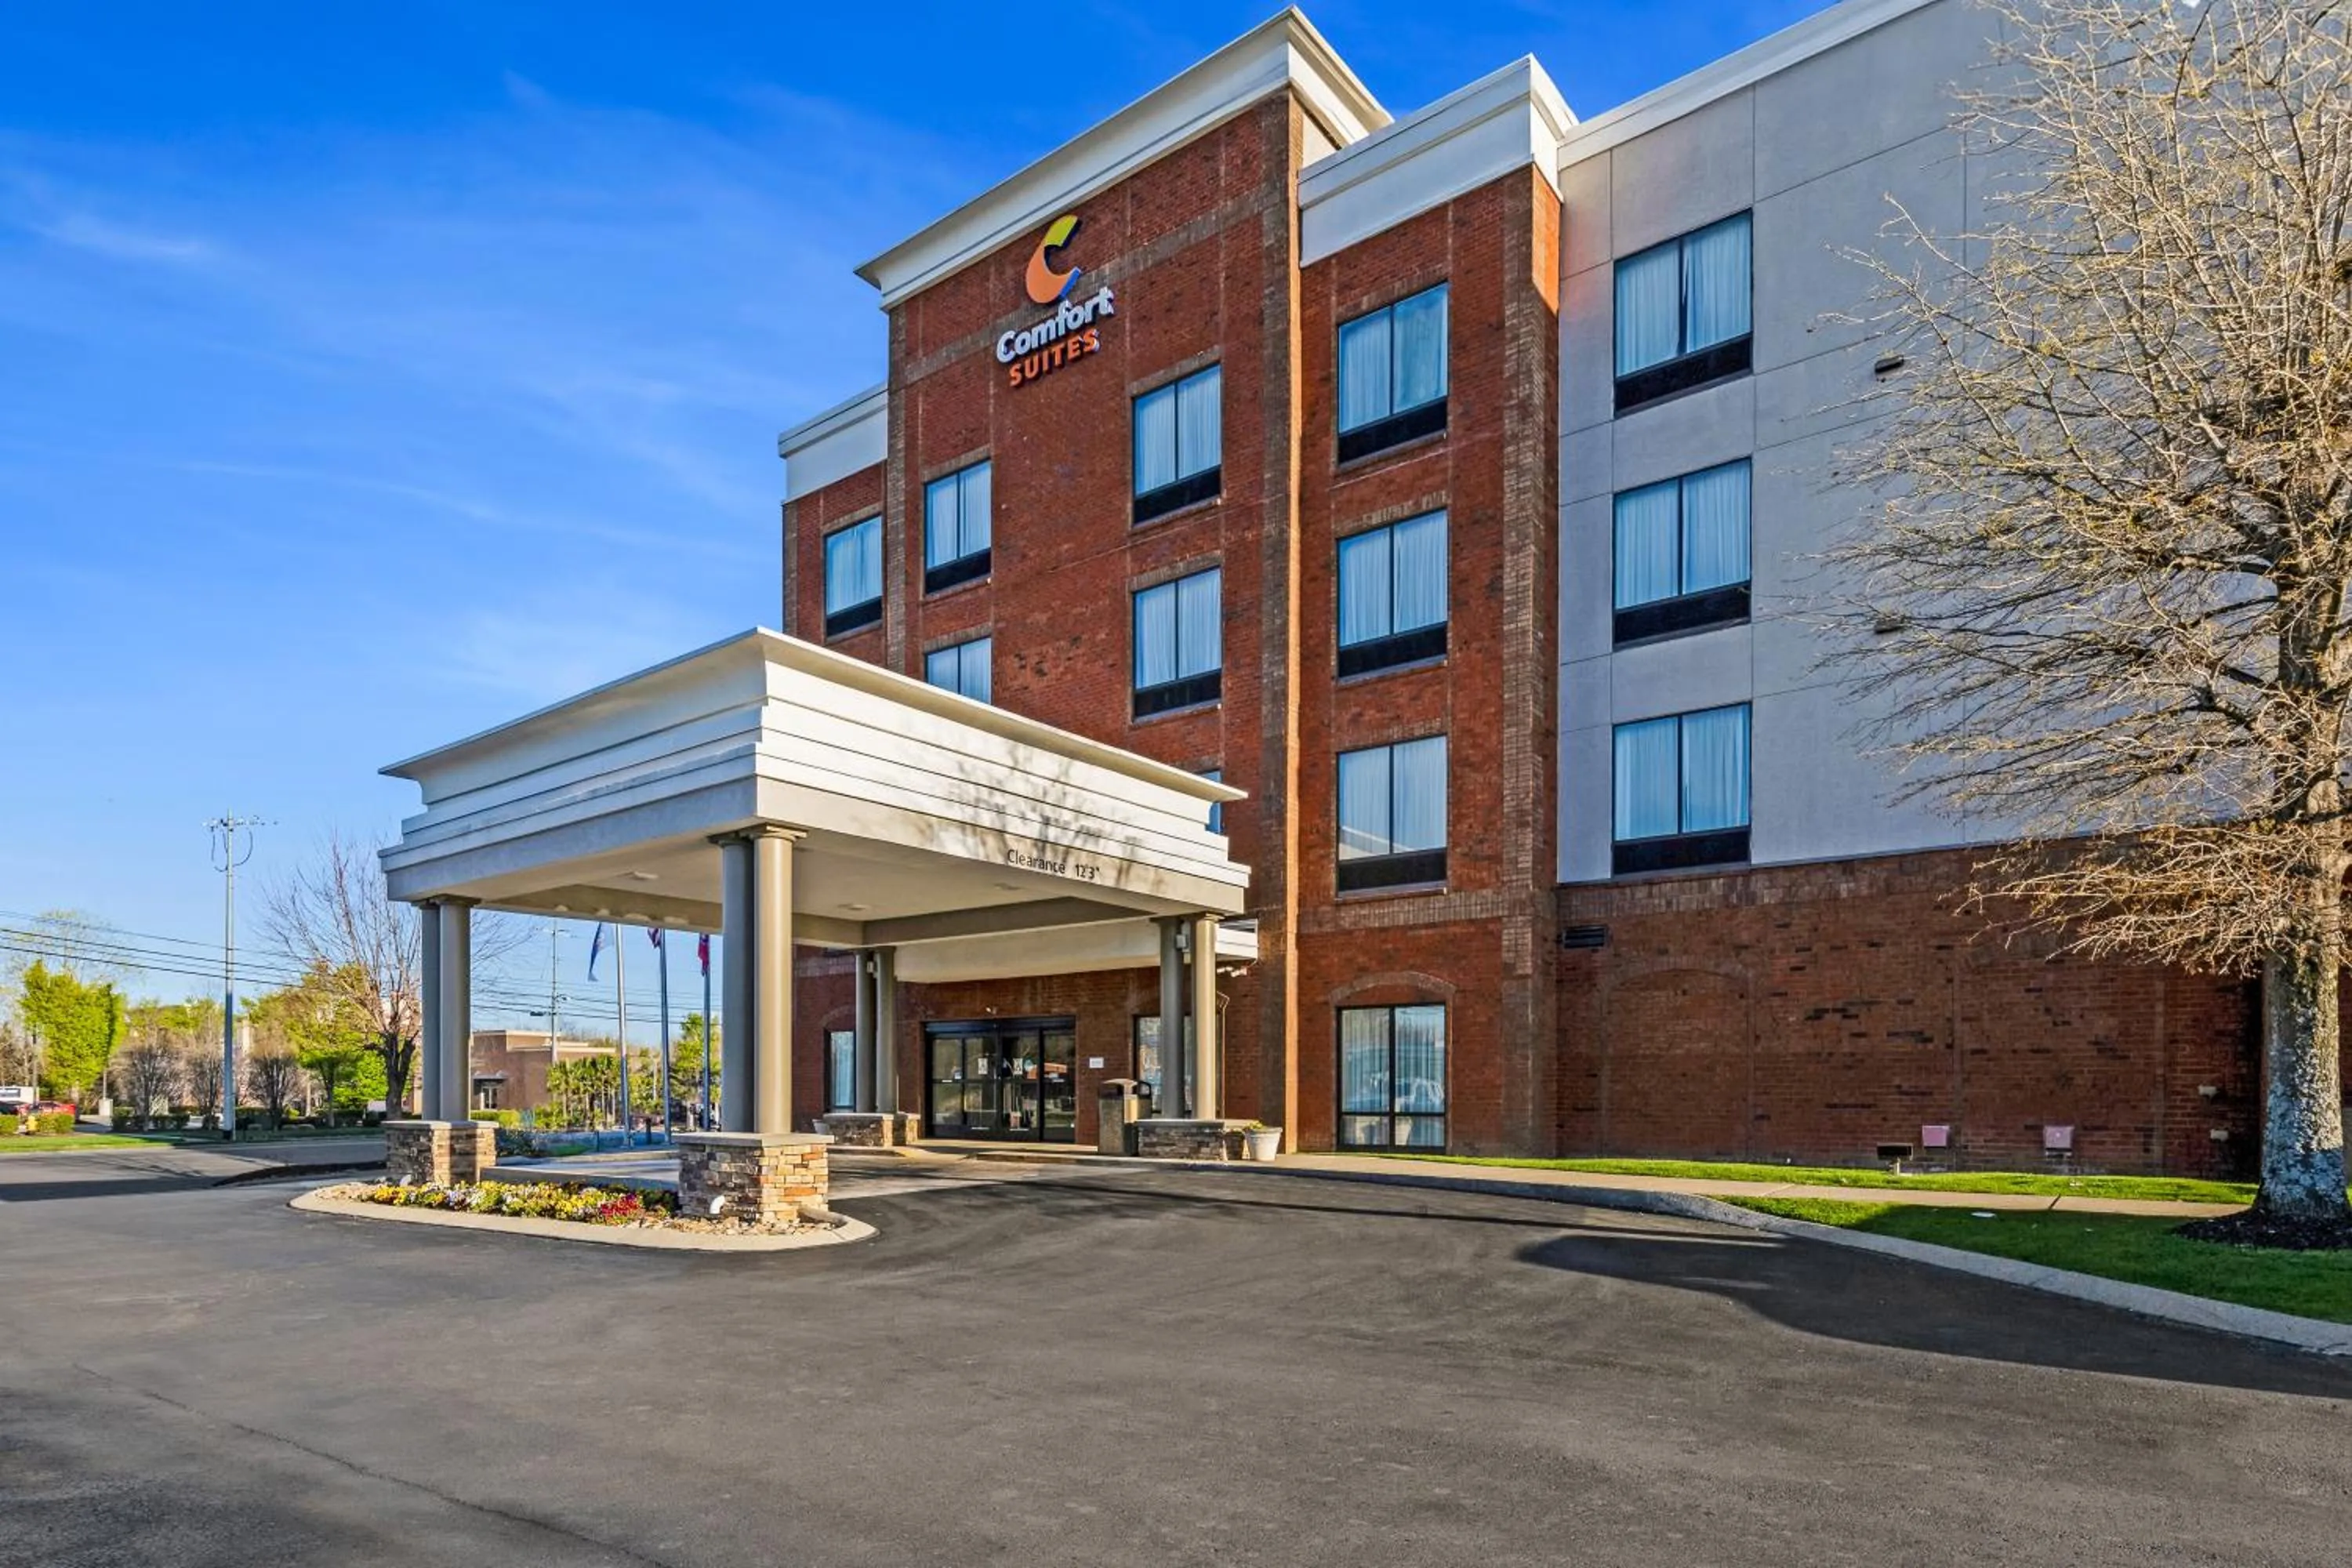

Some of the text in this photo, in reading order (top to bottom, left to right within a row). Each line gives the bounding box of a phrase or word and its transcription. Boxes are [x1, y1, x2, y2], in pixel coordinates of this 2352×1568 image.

[996, 286, 1114, 363] Comfort
[1010, 329, 1100, 387] SUITES
[1007, 849, 1066, 874] Clearance
